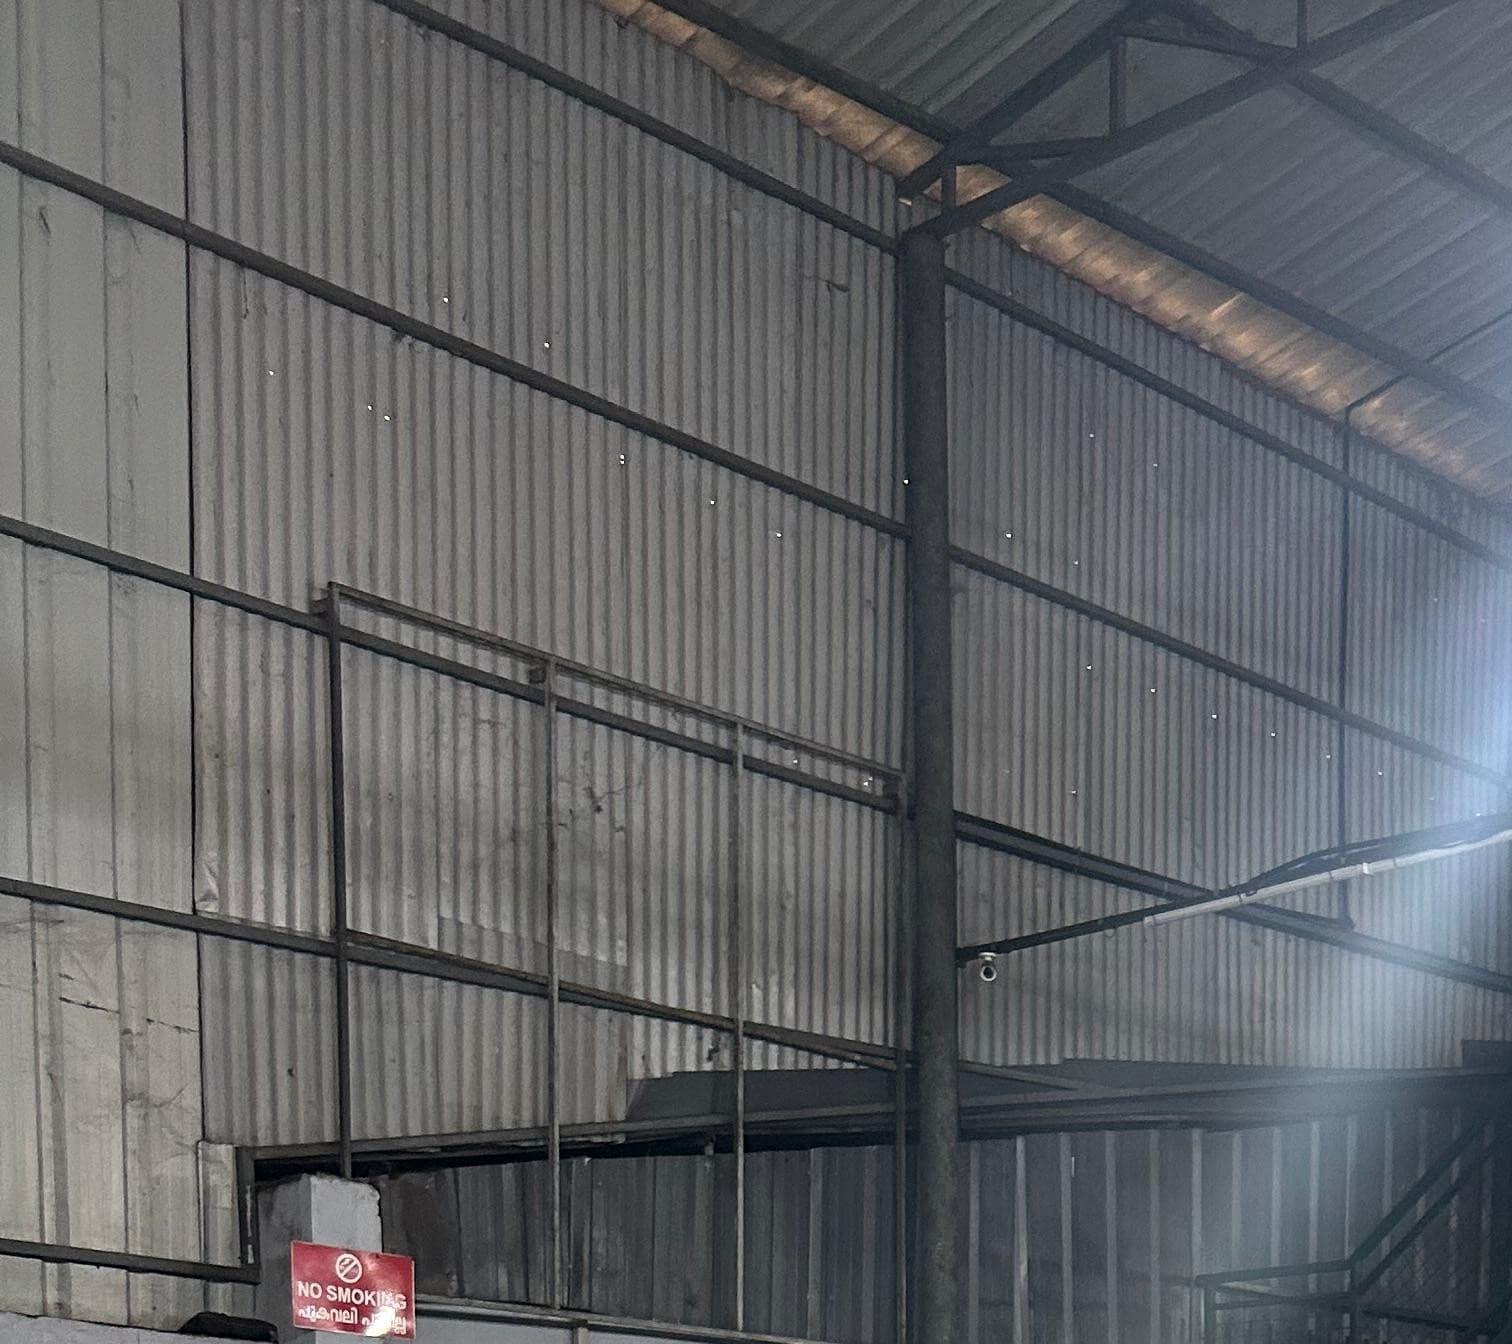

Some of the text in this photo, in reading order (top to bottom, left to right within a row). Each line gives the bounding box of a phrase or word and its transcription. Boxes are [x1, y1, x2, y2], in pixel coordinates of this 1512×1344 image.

[297, 1281, 407, 1310] NO SMOKING
[298, 1304, 359, 1324] പുകവലി
